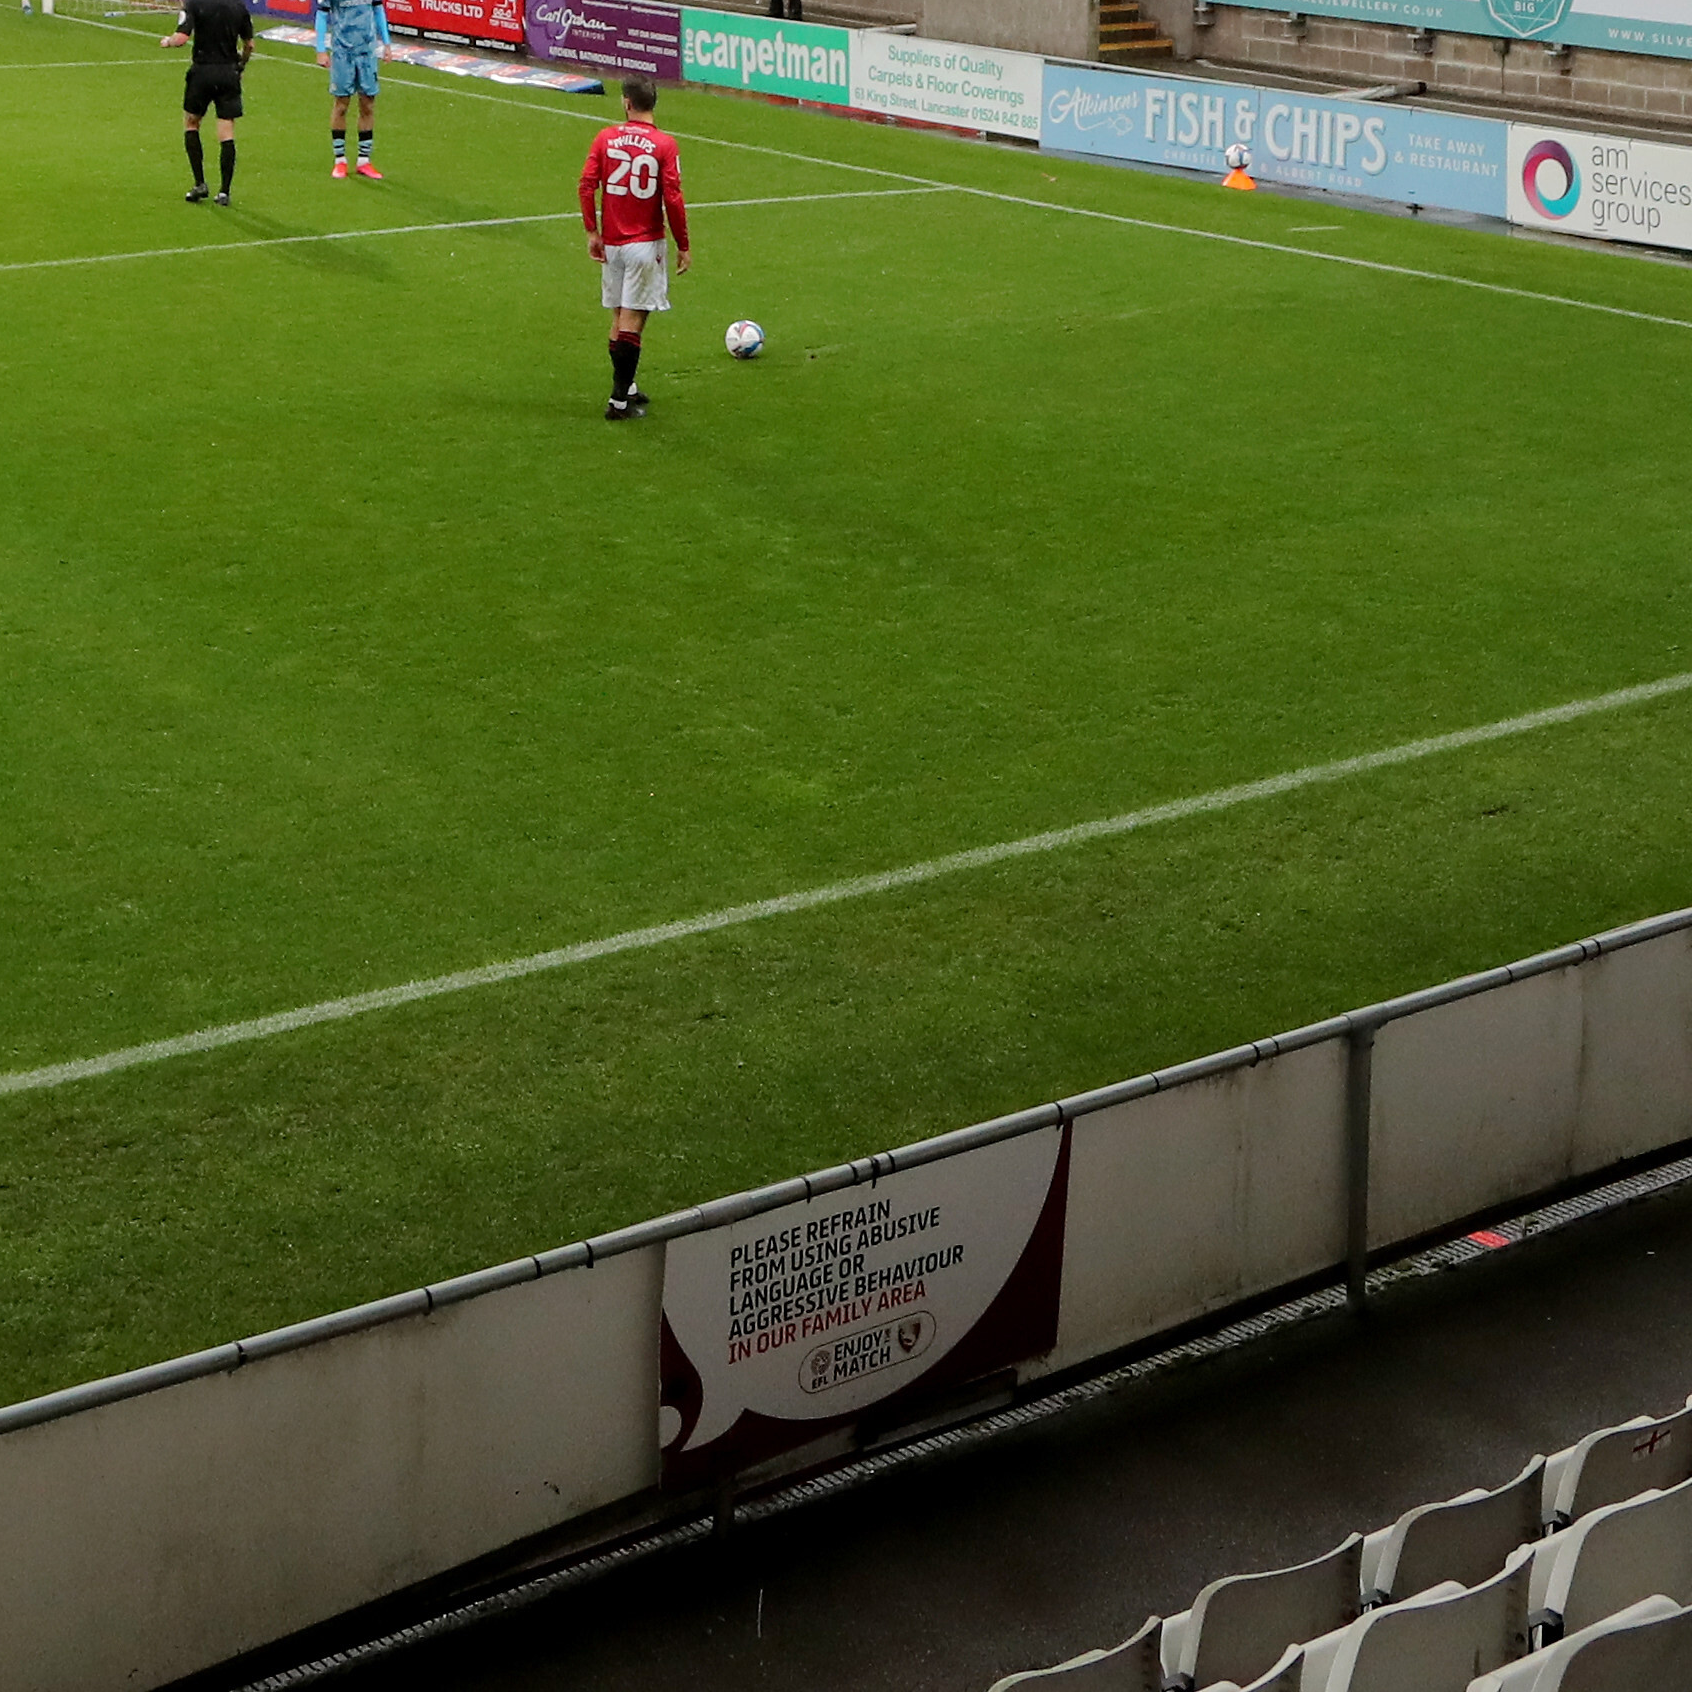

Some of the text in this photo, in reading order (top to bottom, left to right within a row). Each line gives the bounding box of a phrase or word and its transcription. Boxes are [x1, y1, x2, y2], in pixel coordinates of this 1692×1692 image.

[464, 4, 484, 19] LTD
[536, 4, 561, 22] Carl
[1514, 0, 1536, 14] BIG
[572, 29, 606, 41] INTERIORS
[684, 28, 847, 87] the carpetman
[888, 44, 1004, 81] Suppliers of Quality
[868, 65, 1025, 108] Carpets & Floor Coverings
[866, 89, 888, 107] King
[921, 98, 970, 120] Lancaster
[972, 106, 1000, 123] 01524
[1002, 110, 1020, 126] 842
[1022, 114, 1039, 130] 885
[611, 135, 657, 153] PHILLIPS
[1144, 87, 1226, 150] FISH
[1234, 98, 1257, 142] &
[1265, 104, 1387, 176] CHIPS
[1409, 133, 1486, 158] TAKE AWAY
[606, 148, 659, 199] 20
[1393, 150, 1499, 178] & RESTAURANT
[1592, 145, 1629, 170] am
[1275, 166, 1322, 181] ALBERT
[1329, 171, 1363, 187] ROAD
[1591, 172, 1692, 206] services
[1591, 198, 1662, 234] group
[730, 1207, 940, 1293] FROM USING ABUSIVE
[731, 1199, 891, 1268] PLEASE REFRAIN
[728, 1244, 964, 1341] AGGRESSIVE BEHAVIOUR
[729, 1254, 865, 1317] LANGUAGE OR
[728, 1280, 926, 1365] IN OUR FAMILY AREA
[833, 1346, 891, 1381] MATCH
[834, 1330, 884, 1362] ENJOY
[812, 1376, 829, 1389] EFL
